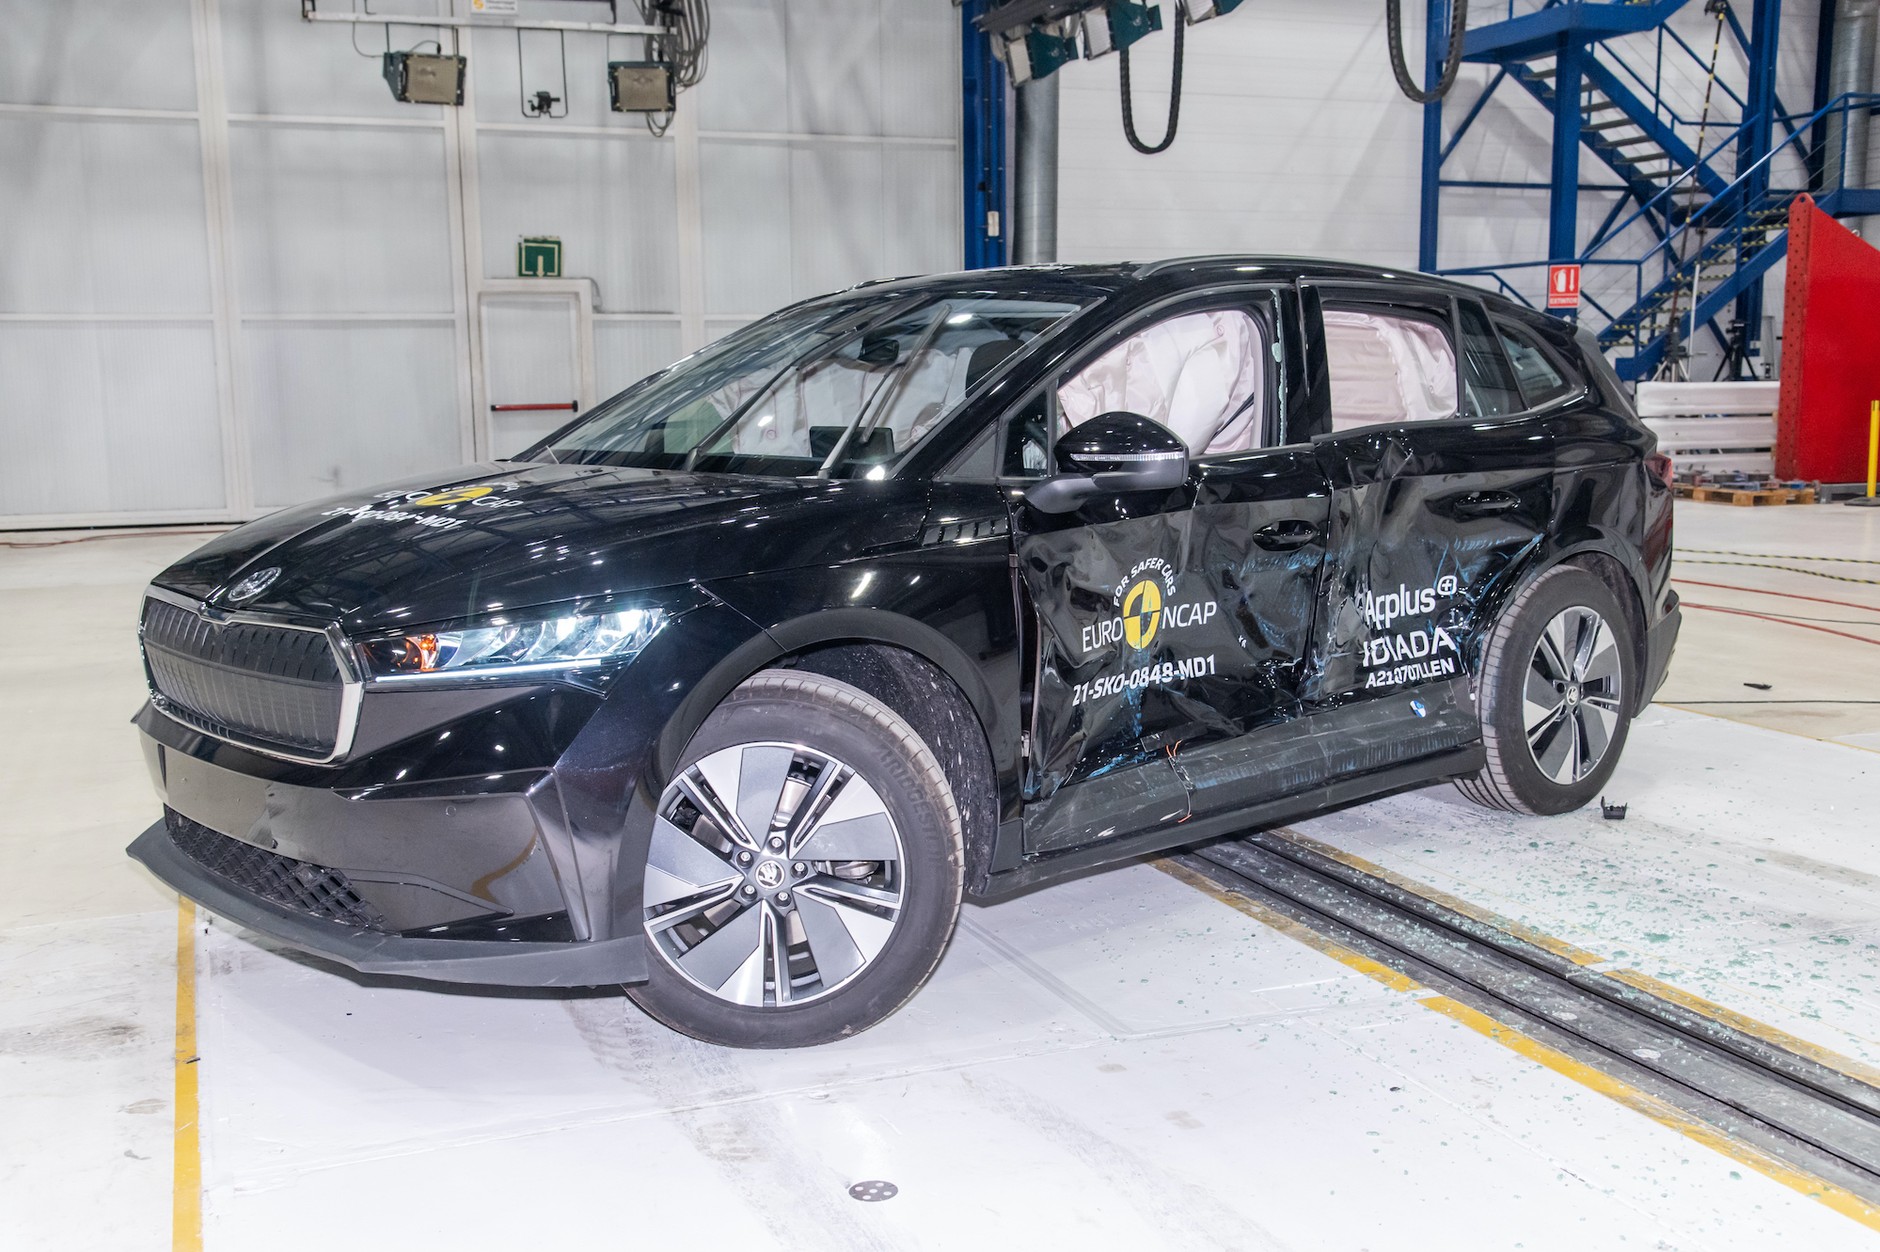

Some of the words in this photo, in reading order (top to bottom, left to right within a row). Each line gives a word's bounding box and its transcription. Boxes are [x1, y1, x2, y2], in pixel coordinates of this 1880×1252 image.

[1113, 576, 1130, 607] FOR
[1130, 557, 1165, 578] SAFER
[1161, 563, 1176, 597] CARS
[1082, 616, 1124, 653] EURO
[1162, 601, 1217, 630] NCAP
[1362, 626, 1457, 667] IDIADA
[1072, 654, 1216, 707] 21-SKO-0848-MD1
